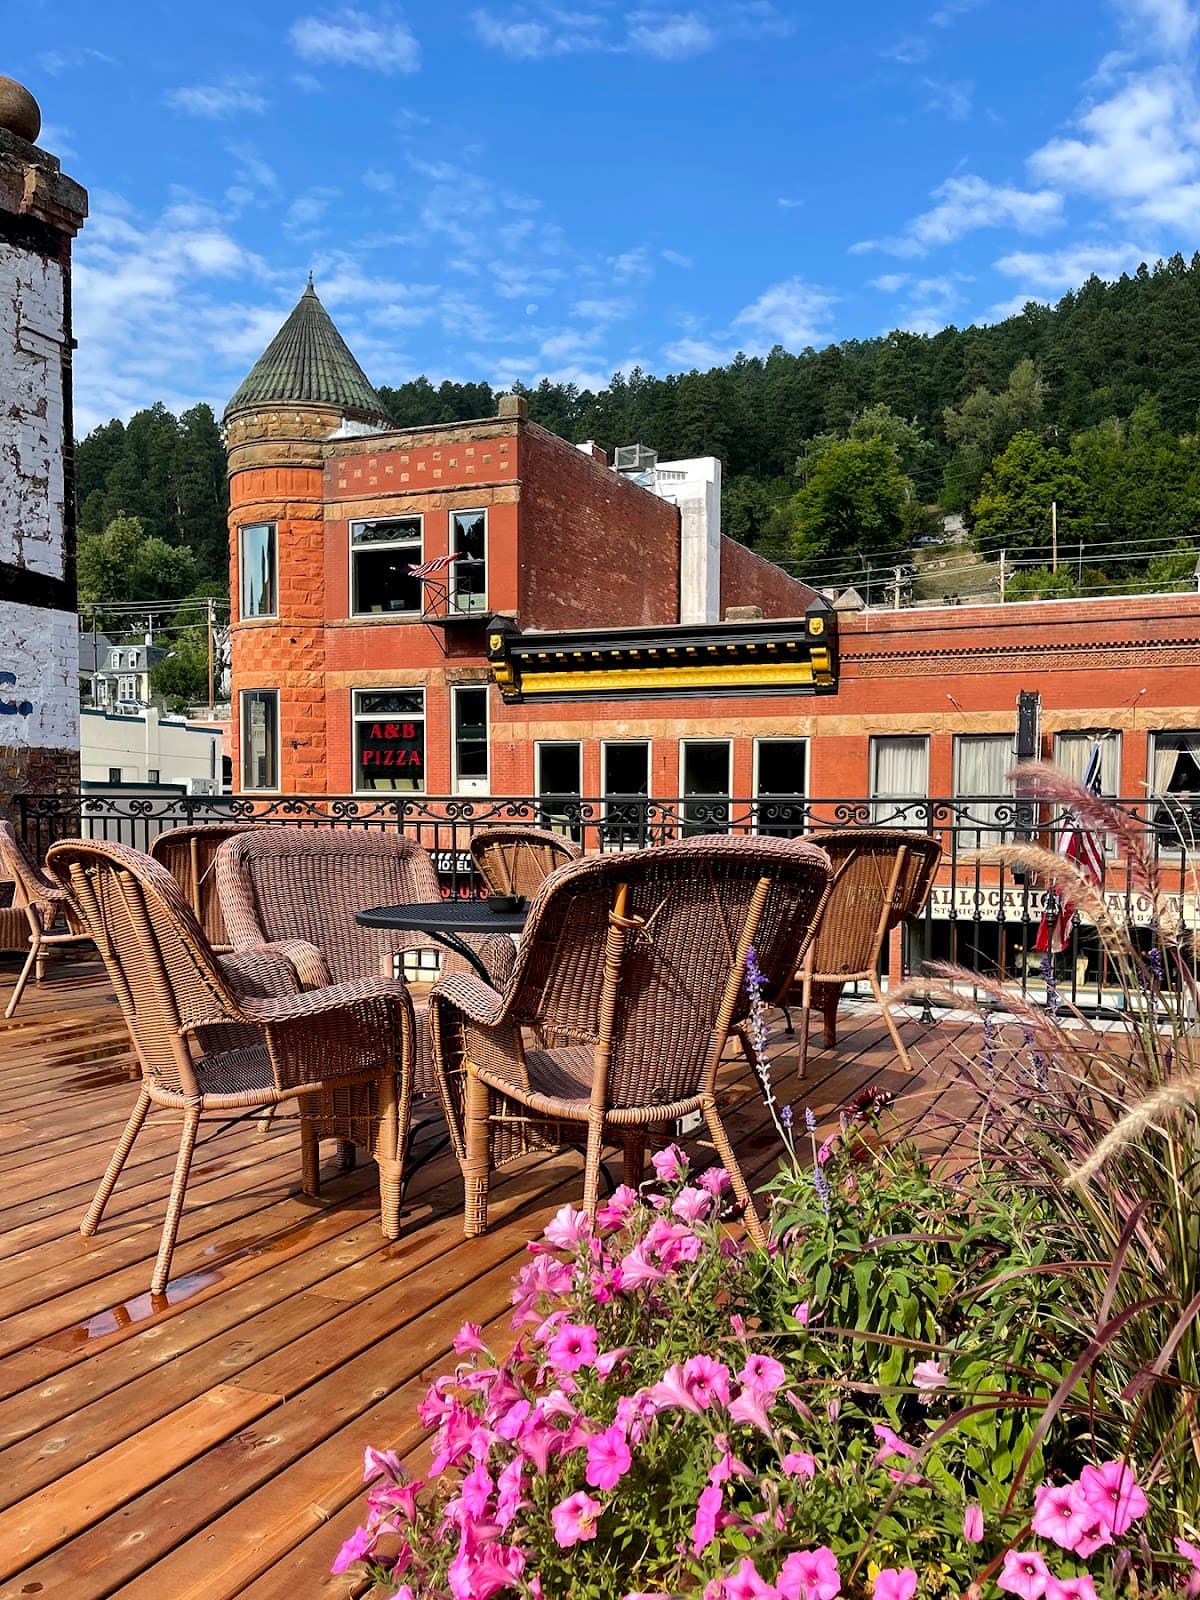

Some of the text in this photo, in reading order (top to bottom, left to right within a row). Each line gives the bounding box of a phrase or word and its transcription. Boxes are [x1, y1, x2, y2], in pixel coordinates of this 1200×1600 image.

[370, 723, 416, 739] A&B
[362, 750, 422, 766] PIZZA
[440, 880, 489, 900] SOS
[960, 891, 1050, 909] LOCATIO
